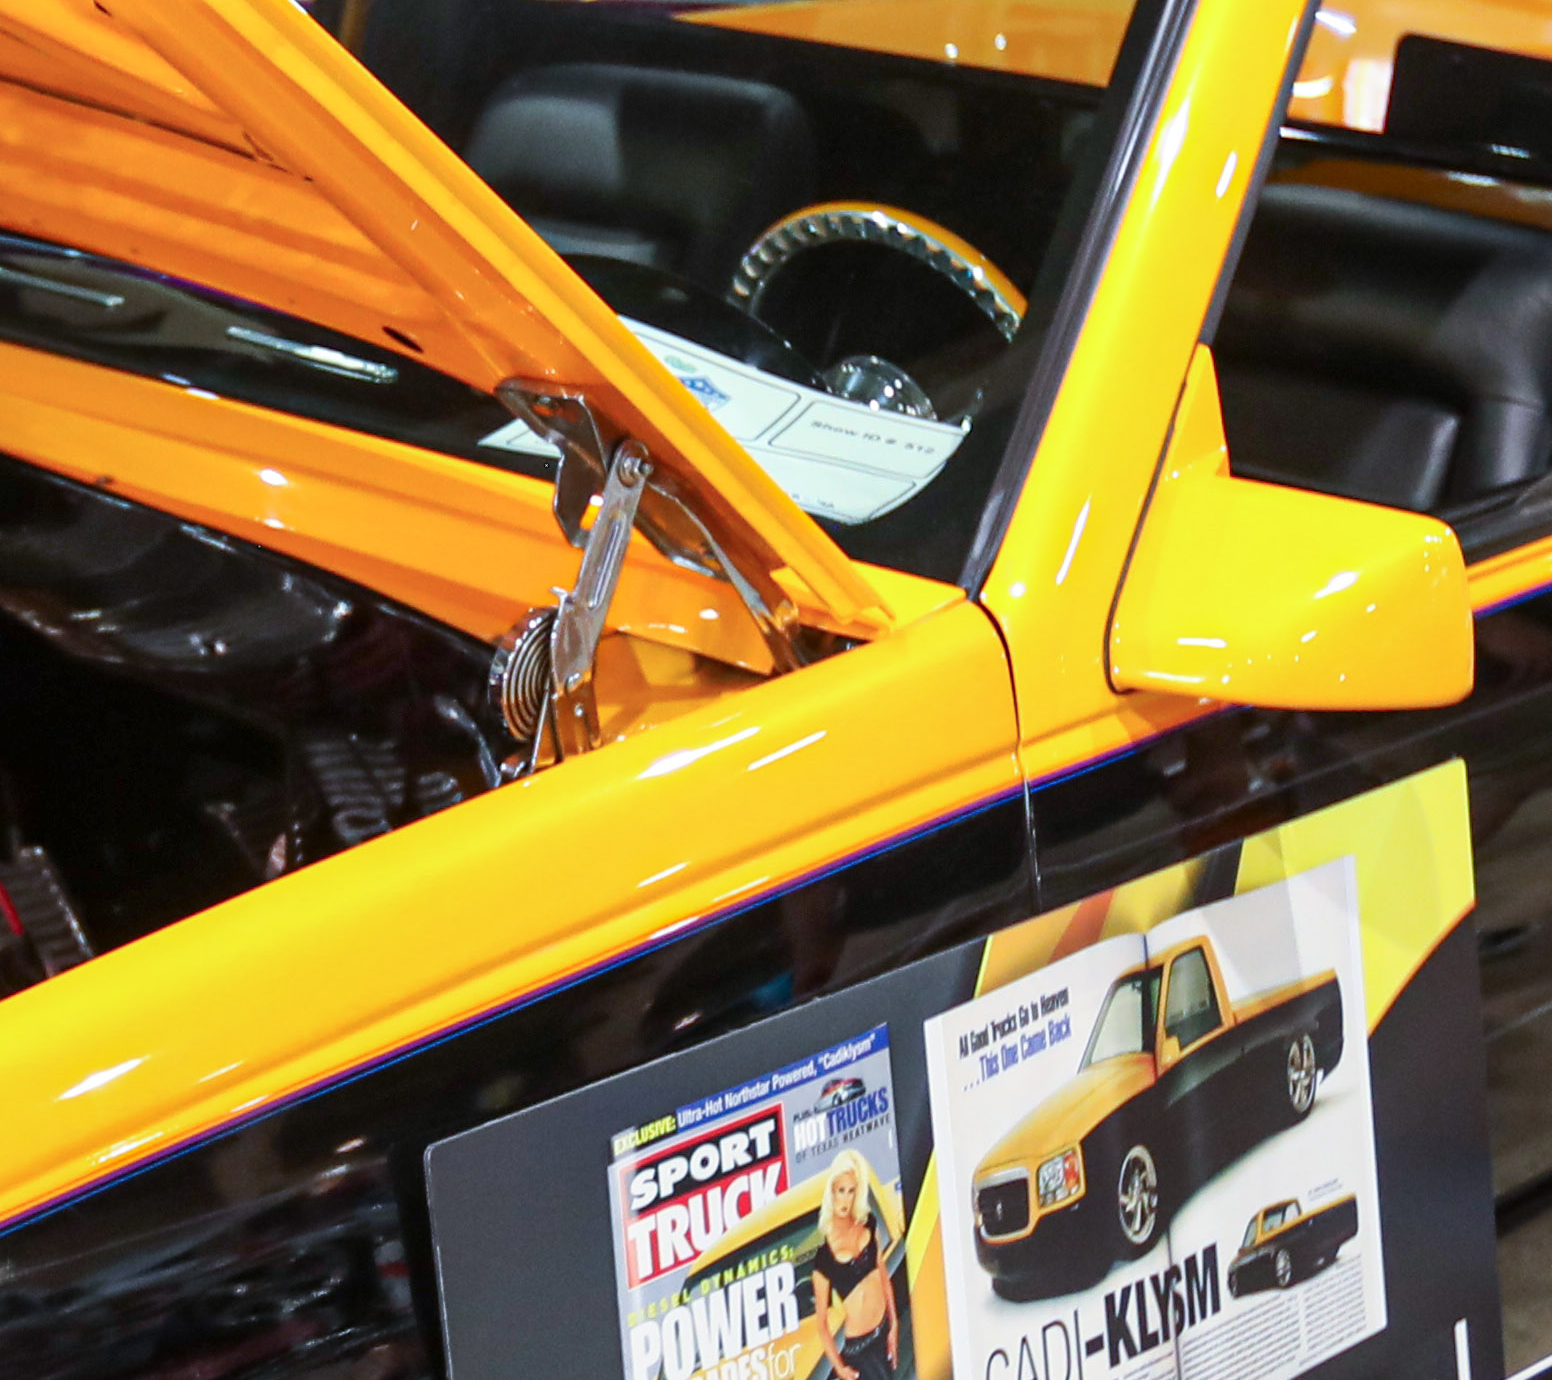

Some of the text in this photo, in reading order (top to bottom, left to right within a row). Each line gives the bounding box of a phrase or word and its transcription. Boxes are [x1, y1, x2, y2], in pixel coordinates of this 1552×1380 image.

[811, 419, 858, 437] Show
[862, 432, 881, 442] ID
[904, 442, 935, 454] 512
[970, 1022, 989, 1053] Good
[991, 1014, 1017, 1042] Trucks
[1019, 1005, 1029, 1028] Go
[1040, 986, 1069, 1017] Heaven
[1001, 1043, 1018, 1071] One
[1021, 1029, 1047, 1060] Came
[1048, 1012, 1071, 1046] Back
[613, 1114, 676, 1156] EXCLUSIVE:
[678, 1097, 724, 1128] Ultra-Hot
[725, 1081, 769, 1107] Northstar
[772, 1061, 818, 1091] Powered,
[796, 1112, 890, 1163] OF TEXAS HEATWAVE
[629, 1119, 776, 1211] SPORT
[627, 1161, 783, 1280] TRUCK
[627, 1286, 691, 1327] DIESEL
